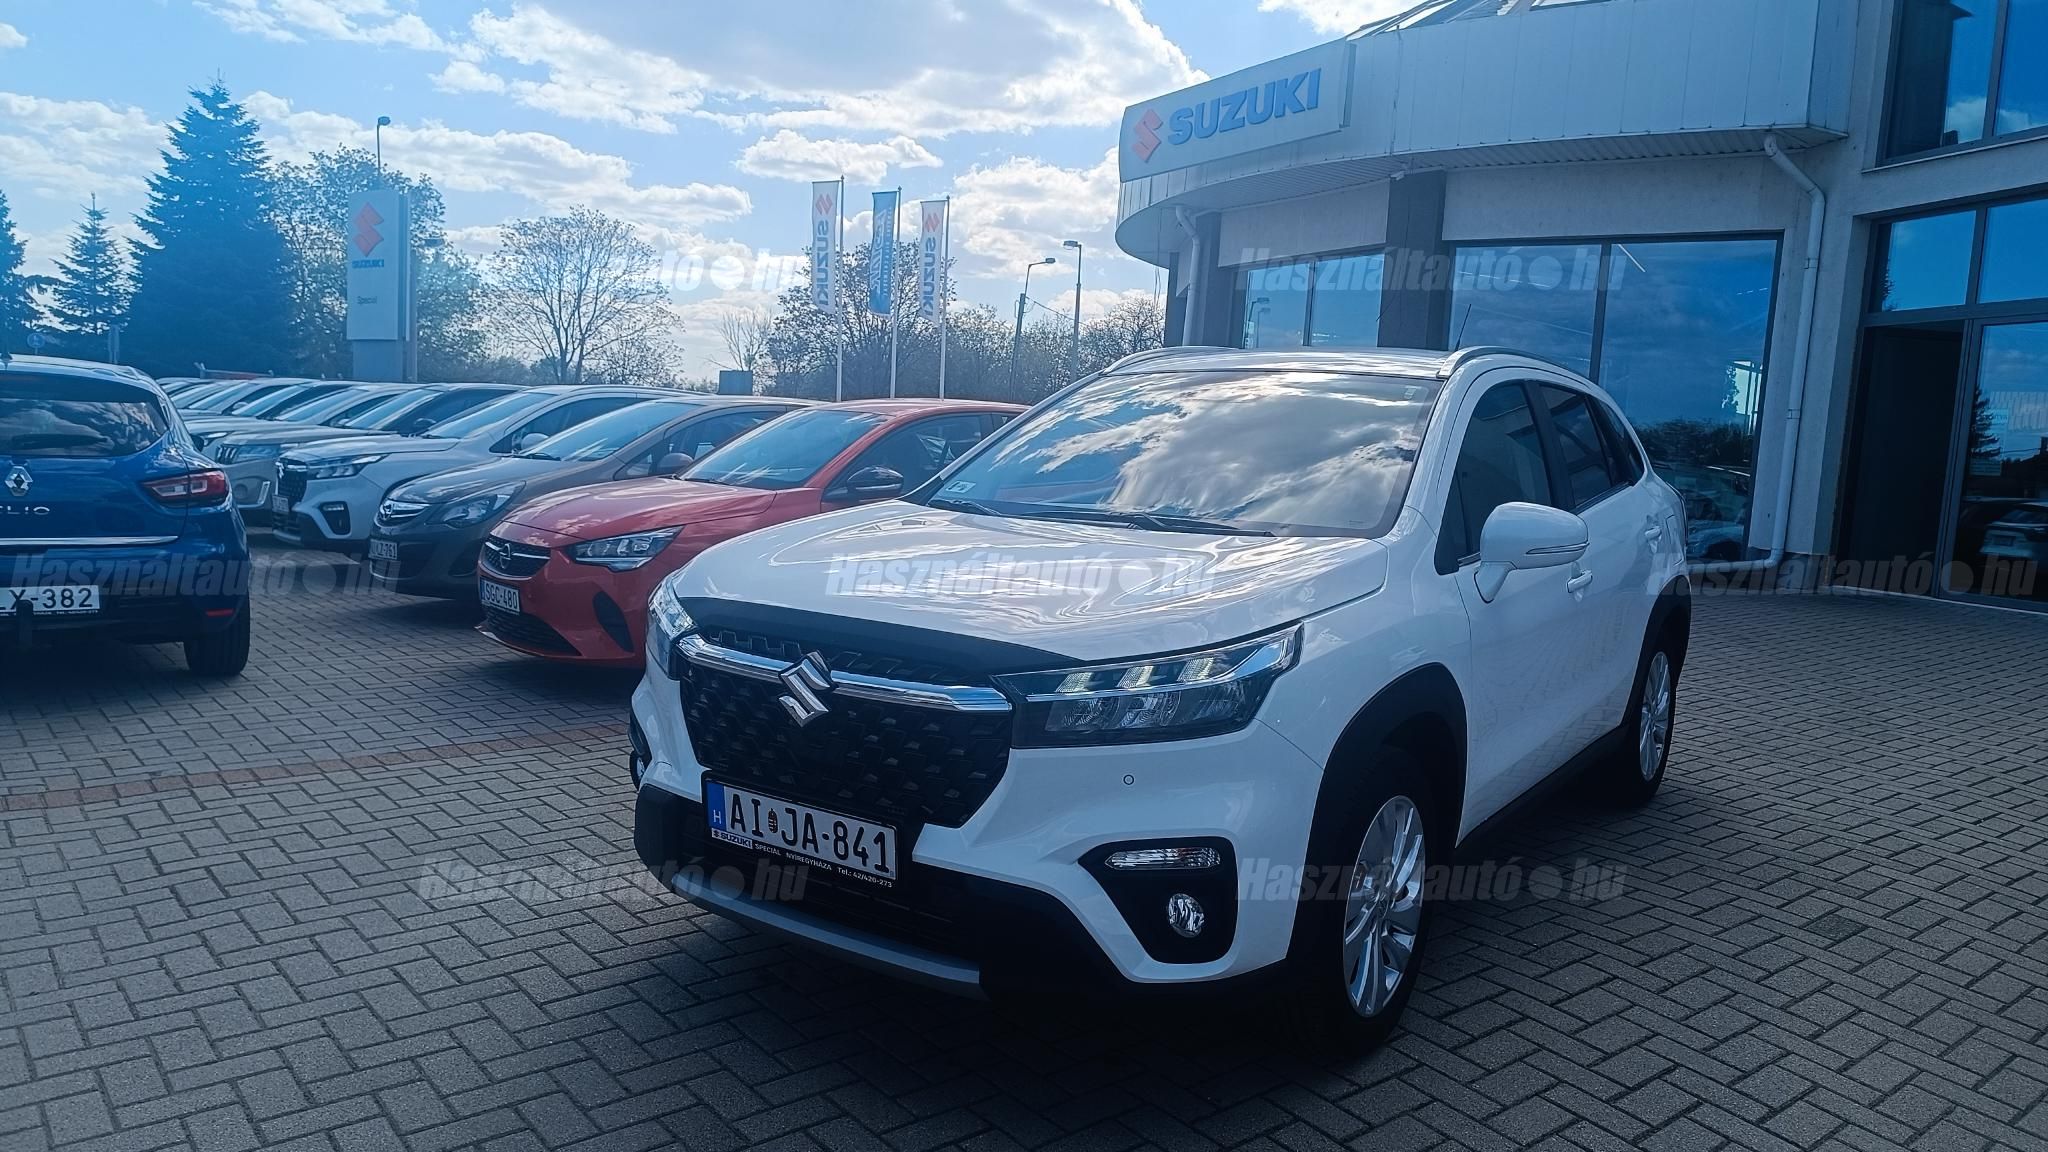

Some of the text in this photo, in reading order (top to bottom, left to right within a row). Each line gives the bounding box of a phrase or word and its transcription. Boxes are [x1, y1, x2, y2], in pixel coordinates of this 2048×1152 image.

[1168, 68, 1322, 145] SUZUKI
[485, 583, 518, 610] SGC-480
[712, 809, 722, 825] H
[730, 793, 890, 875] AI JA-841
[720, 832, 752, 849] SUZUKI
[852, 871, 893, 888] 42/420-273
